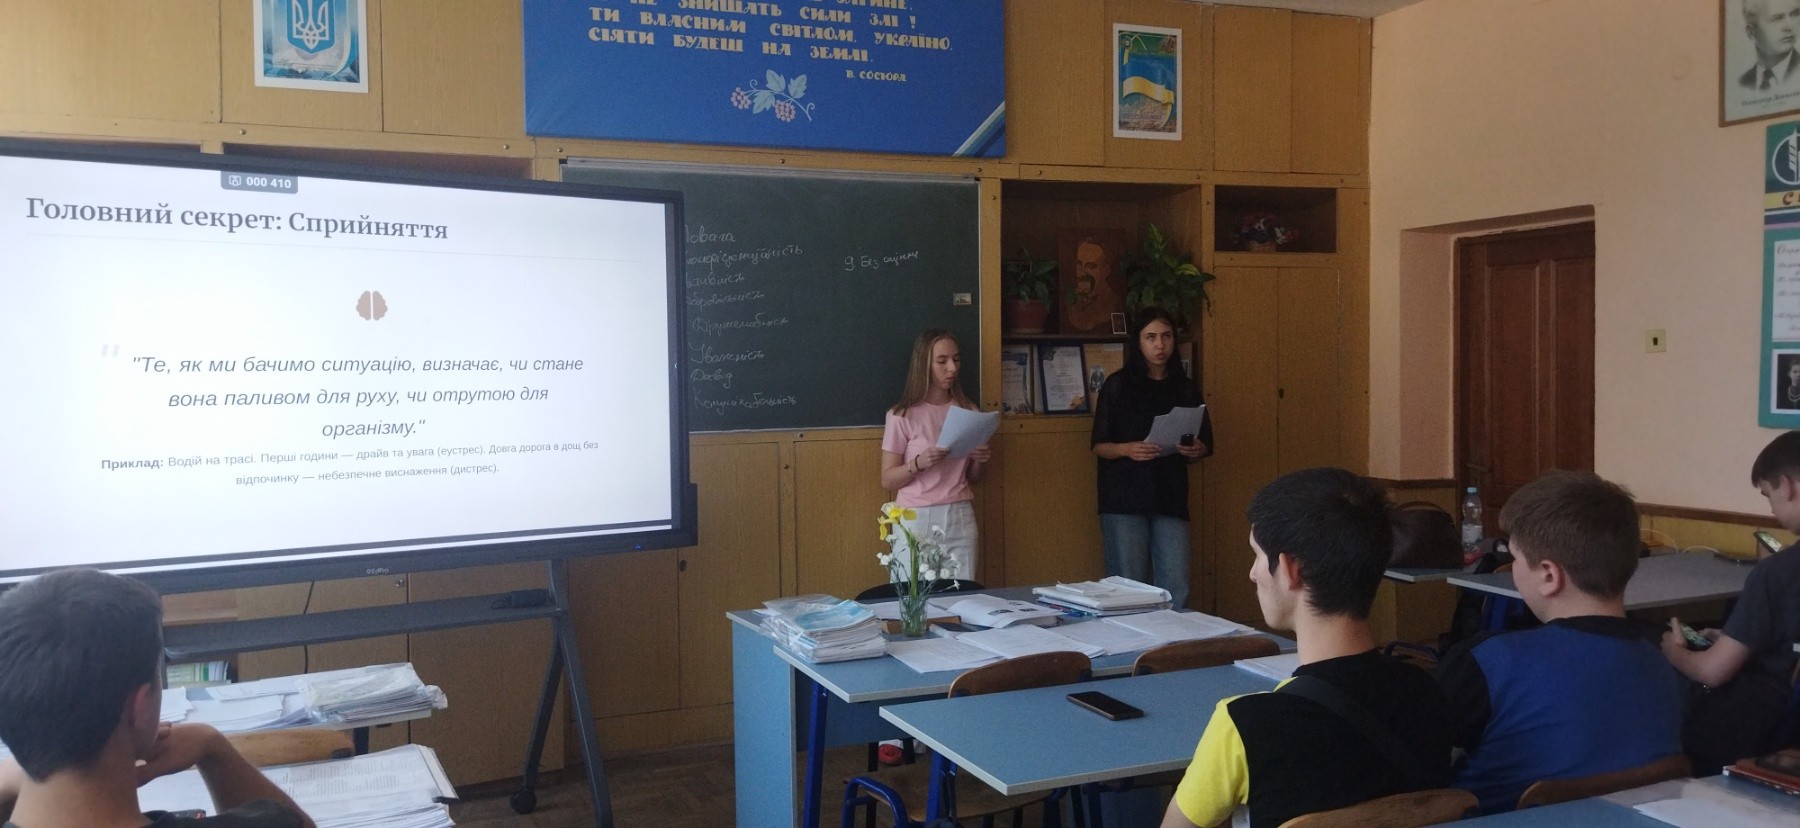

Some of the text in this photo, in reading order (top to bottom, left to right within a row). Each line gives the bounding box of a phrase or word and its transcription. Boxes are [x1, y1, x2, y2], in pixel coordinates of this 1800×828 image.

[589, 7, 620, 22] ТИ
[640, 12, 746, 33] ВЛАСНИМ
[800, 6, 851, 23] СИЛИ
[869, 13, 898, 27] ЗЛІ
[588, 27, 874, 62] СІЯТИ БУДЕШ НА ЗЕМЛІ.
[845, 69, 907, 82] В. СОСЮРА
[246, 176, 292, 189] 000 410
[26, 197, 448, 239] Головний секрет: Сприйняття
[133, 356, 584, 375] "Те, як ми бачимо ситуацію, визначає, чи стане
[168, 387, 549, 407] вона паливом для руху, чи отрутою для
[322, 419, 425, 440] організму."
[101, 458, 164, 471] Приклад:
[168, 456, 202, 468] Водій
[206, 457, 220, 466] на
[225, 454, 257, 466] трасі.
[260, 452, 297, 464] Перші
[300, 450, 338, 462] години
[356, 448, 389, 460] драйв
[392, 448, 404, 457] та
[406, 447, 434, 458] увага
[437, 444, 486, 457] (еустрес).
[488, 443, 517, 454] Довга
[519, 442, 551, 453] дорога
[553, 443, 559, 451] в
[561, 442, 581, 452] дощ
[583, 440, 599, 449] без
[236, 473, 299, 486] відпочинку
[318, 469, 382, 481] небезпечне
[385, 466, 447, 478] виснаження
[450, 463, 500, 476] (дистрес).
